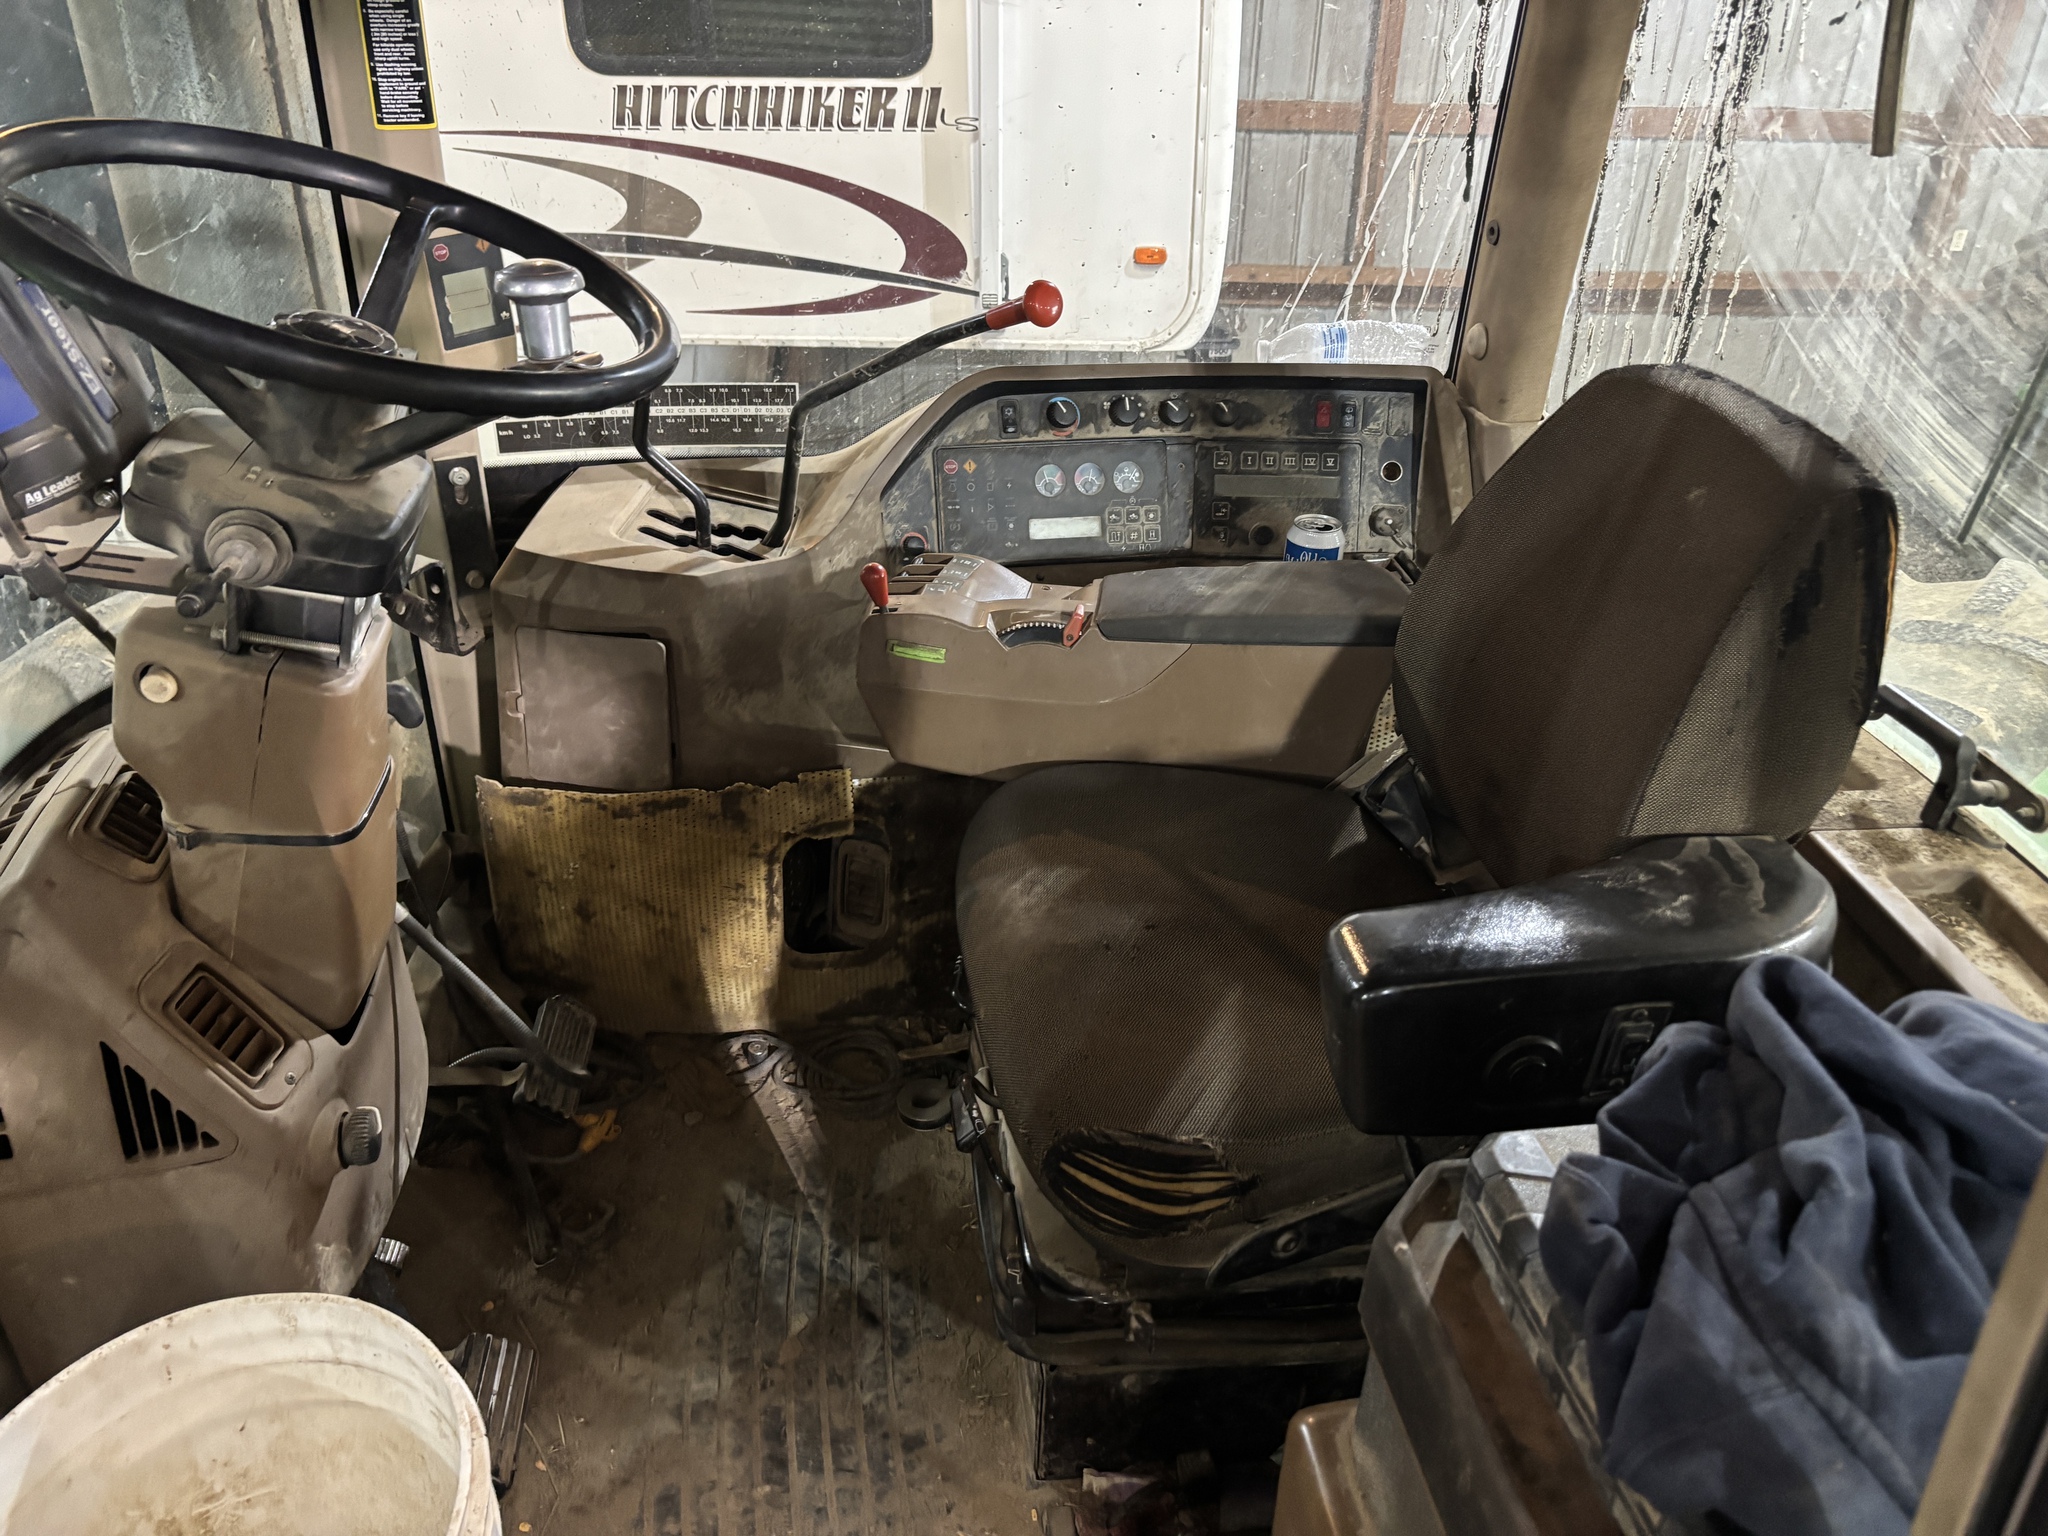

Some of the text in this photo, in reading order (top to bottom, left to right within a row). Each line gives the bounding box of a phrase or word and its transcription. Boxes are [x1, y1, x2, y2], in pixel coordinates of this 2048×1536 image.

[612, 84, 898, 131] HITCHHIKER
[902, 87, 943, 132] II
[40, 307, 100, 395] EZ-Steer
[1326, 458, 1335, 466] V
[25, 491, 43, 504] Ag
[42, 472, 81, 497] Leader
